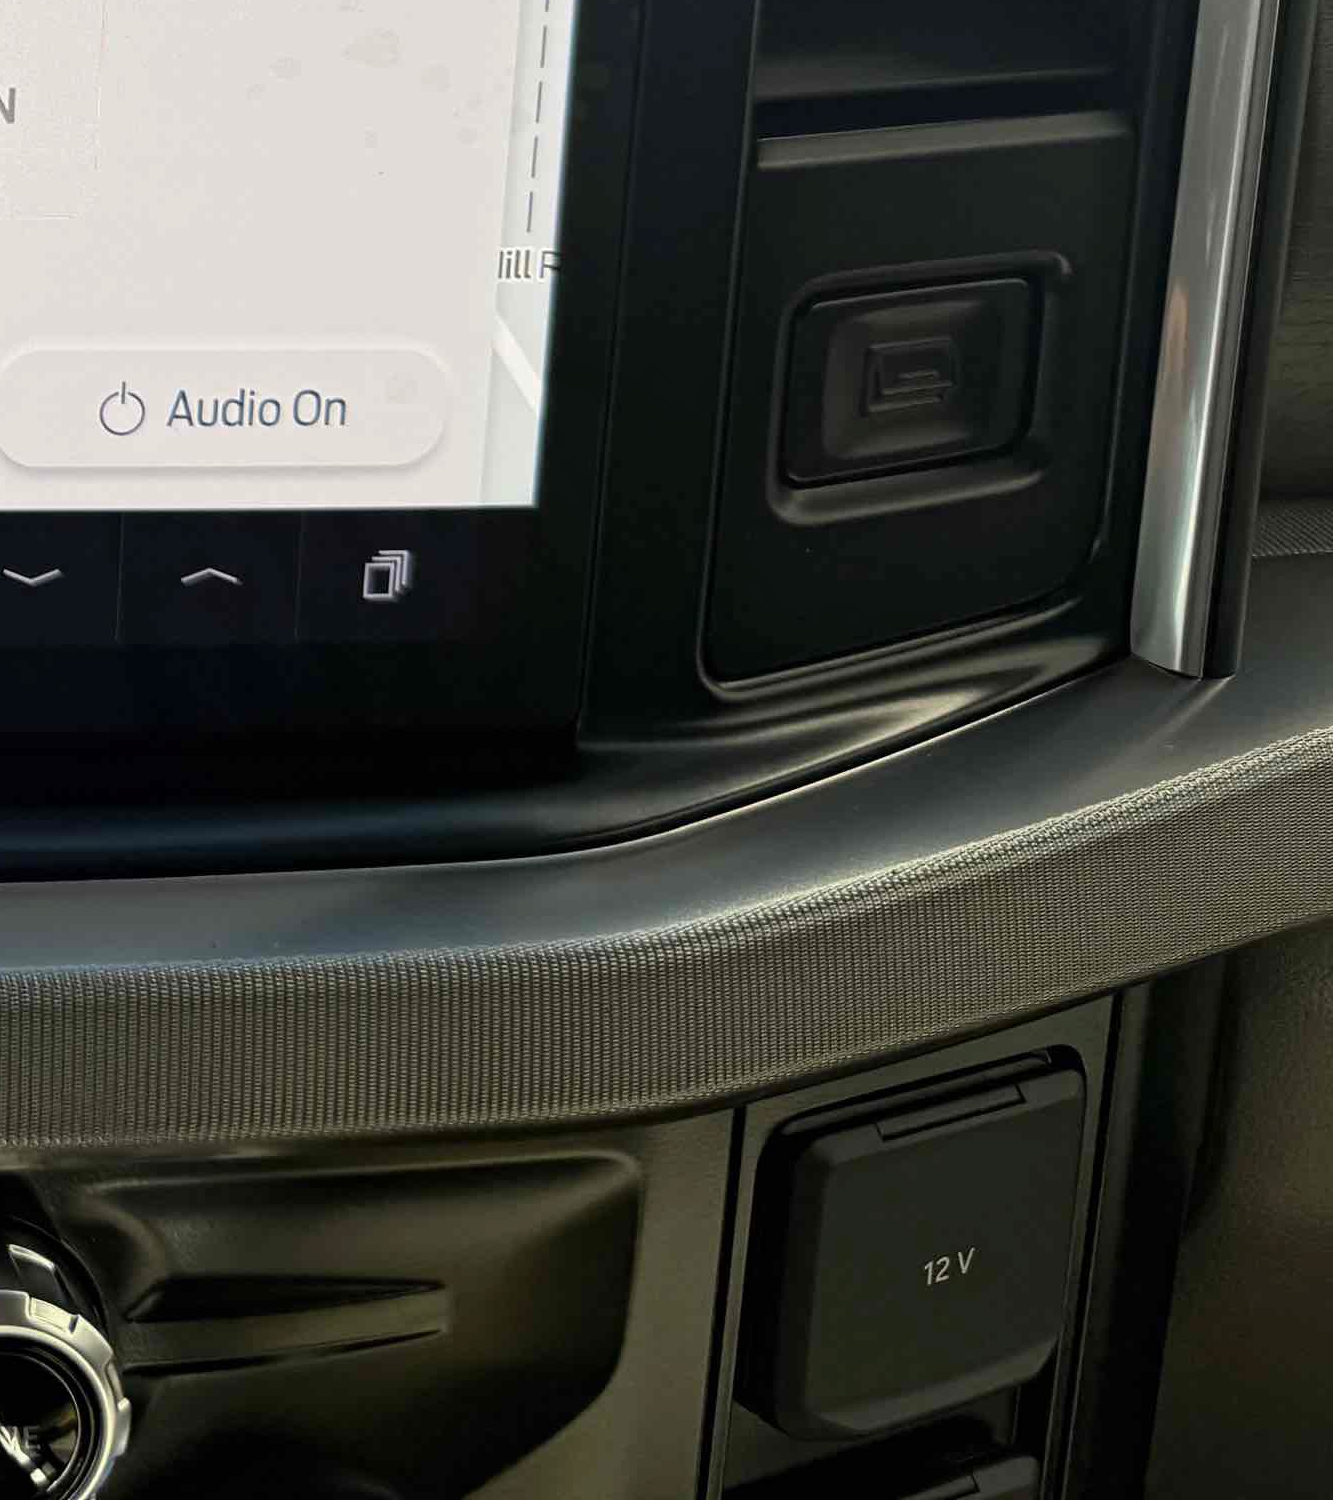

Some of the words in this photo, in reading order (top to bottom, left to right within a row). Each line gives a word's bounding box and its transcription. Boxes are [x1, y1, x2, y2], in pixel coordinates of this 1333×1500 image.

[166, 389, 281, 427] Audio
[292, 389, 347, 427] On
[923, 1255, 951, 1286] 12
[956, 1247, 976, 1276] V
